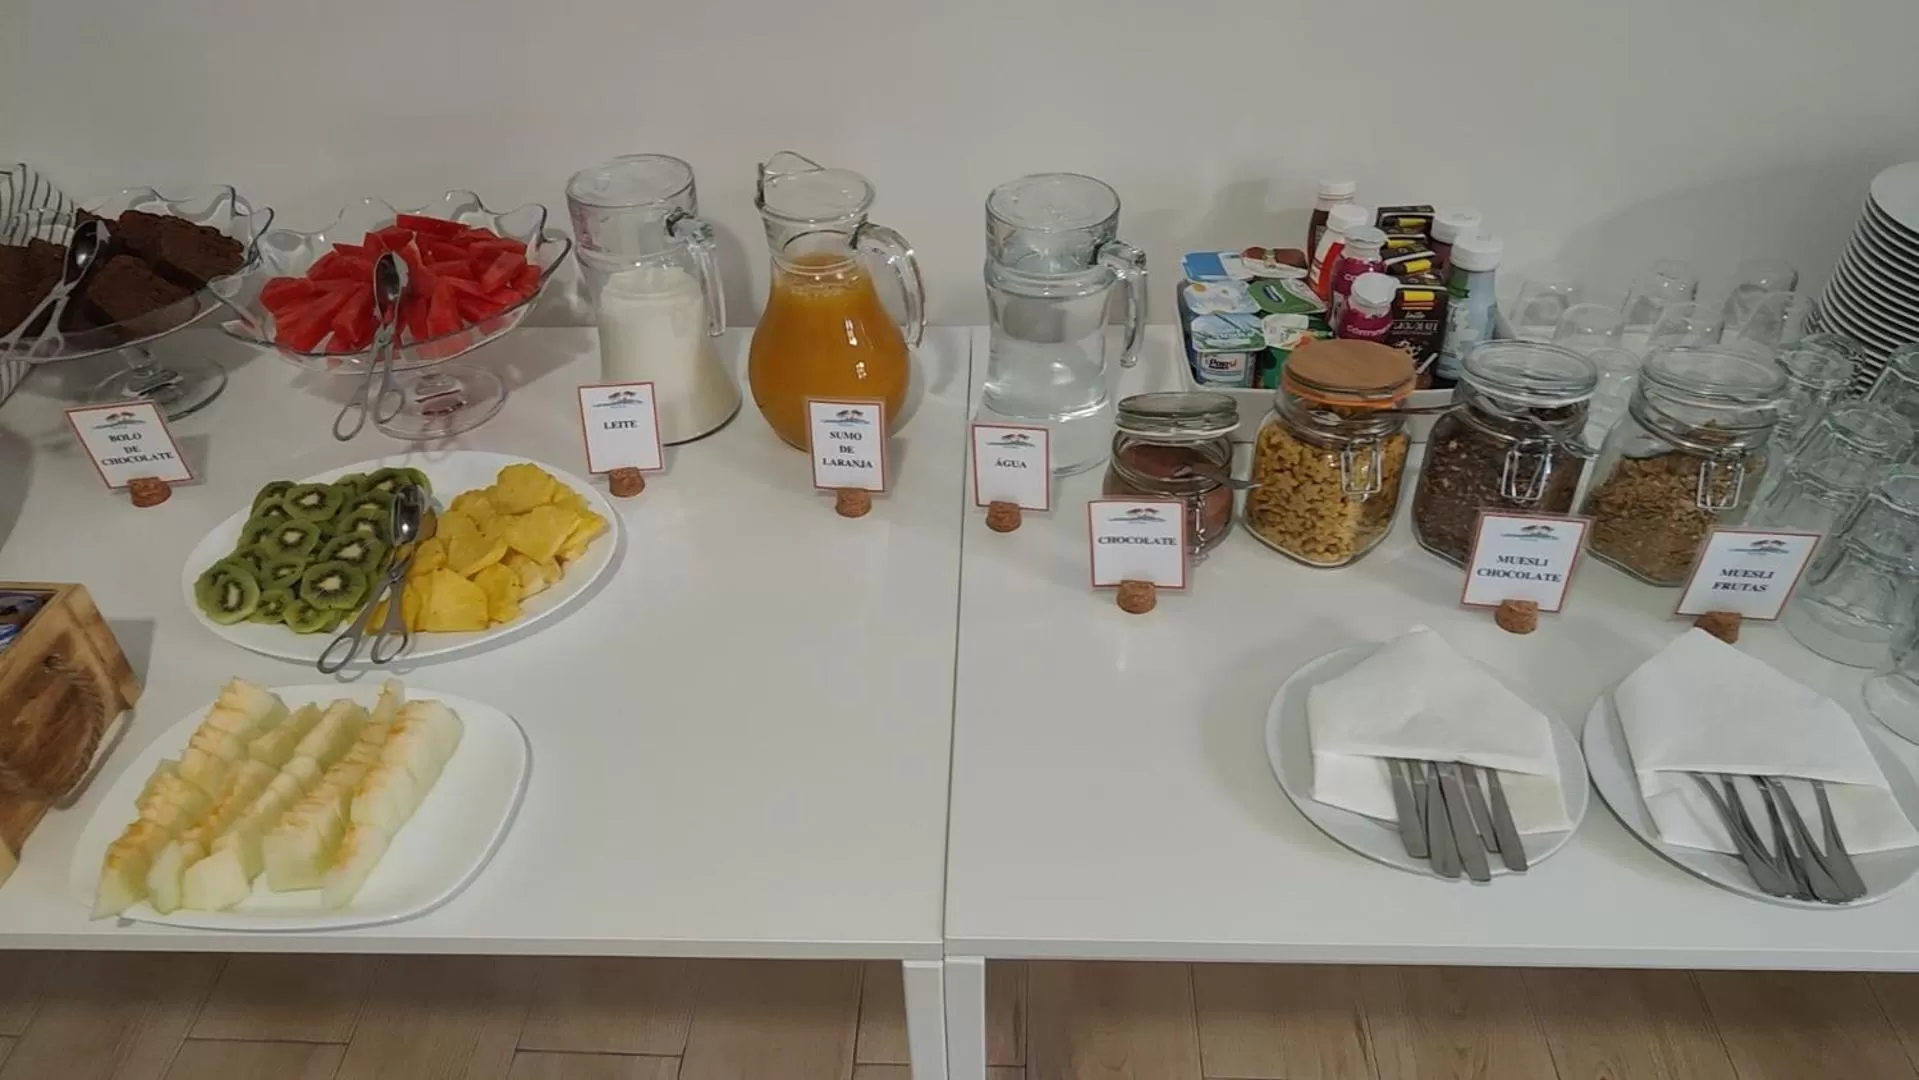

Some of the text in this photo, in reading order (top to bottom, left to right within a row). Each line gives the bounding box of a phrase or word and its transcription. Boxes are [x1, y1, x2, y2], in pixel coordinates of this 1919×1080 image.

[603, 420, 638, 429] LEITE
[108, 432, 142, 442] BOLO
[829, 431, 862, 440] SUMO
[124, 446, 141, 454] DE
[840, 445, 855, 453] DE
[101, 452, 175, 466] CHOCOLATE
[822, 458, 873, 468] LARANJA
[1098, 536, 1177, 545] CHOCOLATE
[1497, 555, 1548, 567] MUESLI
[1476, 568, 1562, 582] CHOCOLATE
[1720, 569, 1775, 579] MUESLI
[1712, 582, 1768, 592] FRUTAS
